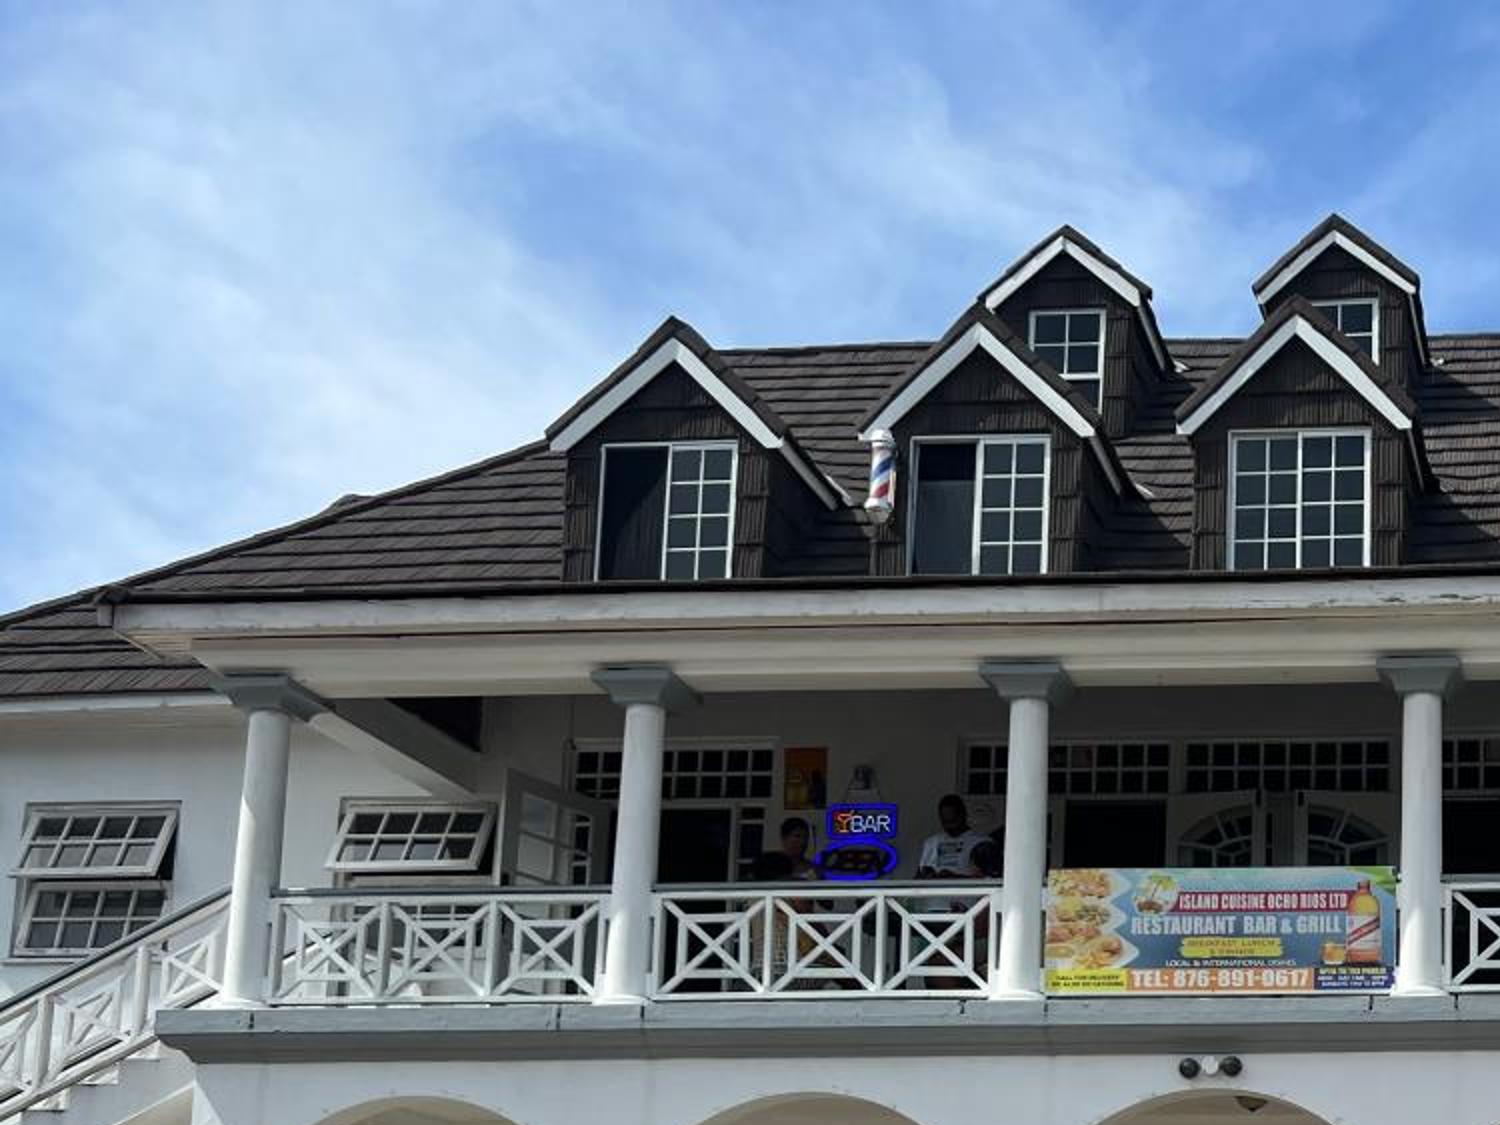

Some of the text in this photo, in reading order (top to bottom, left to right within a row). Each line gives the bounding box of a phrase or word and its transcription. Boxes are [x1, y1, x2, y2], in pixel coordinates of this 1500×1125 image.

[850, 815, 891, 833] BAR
[1179, 894, 1218, 910] ISLAND
[1221, 893, 1265, 909] CUISINE
[1267, 893, 1299, 909] OCHO
[1329, 893, 1347, 908] LTD
[1131, 915, 1343, 935] RESTAURANT BAR & GRILL
[1174, 969, 1307, 987] 876-891-0617
